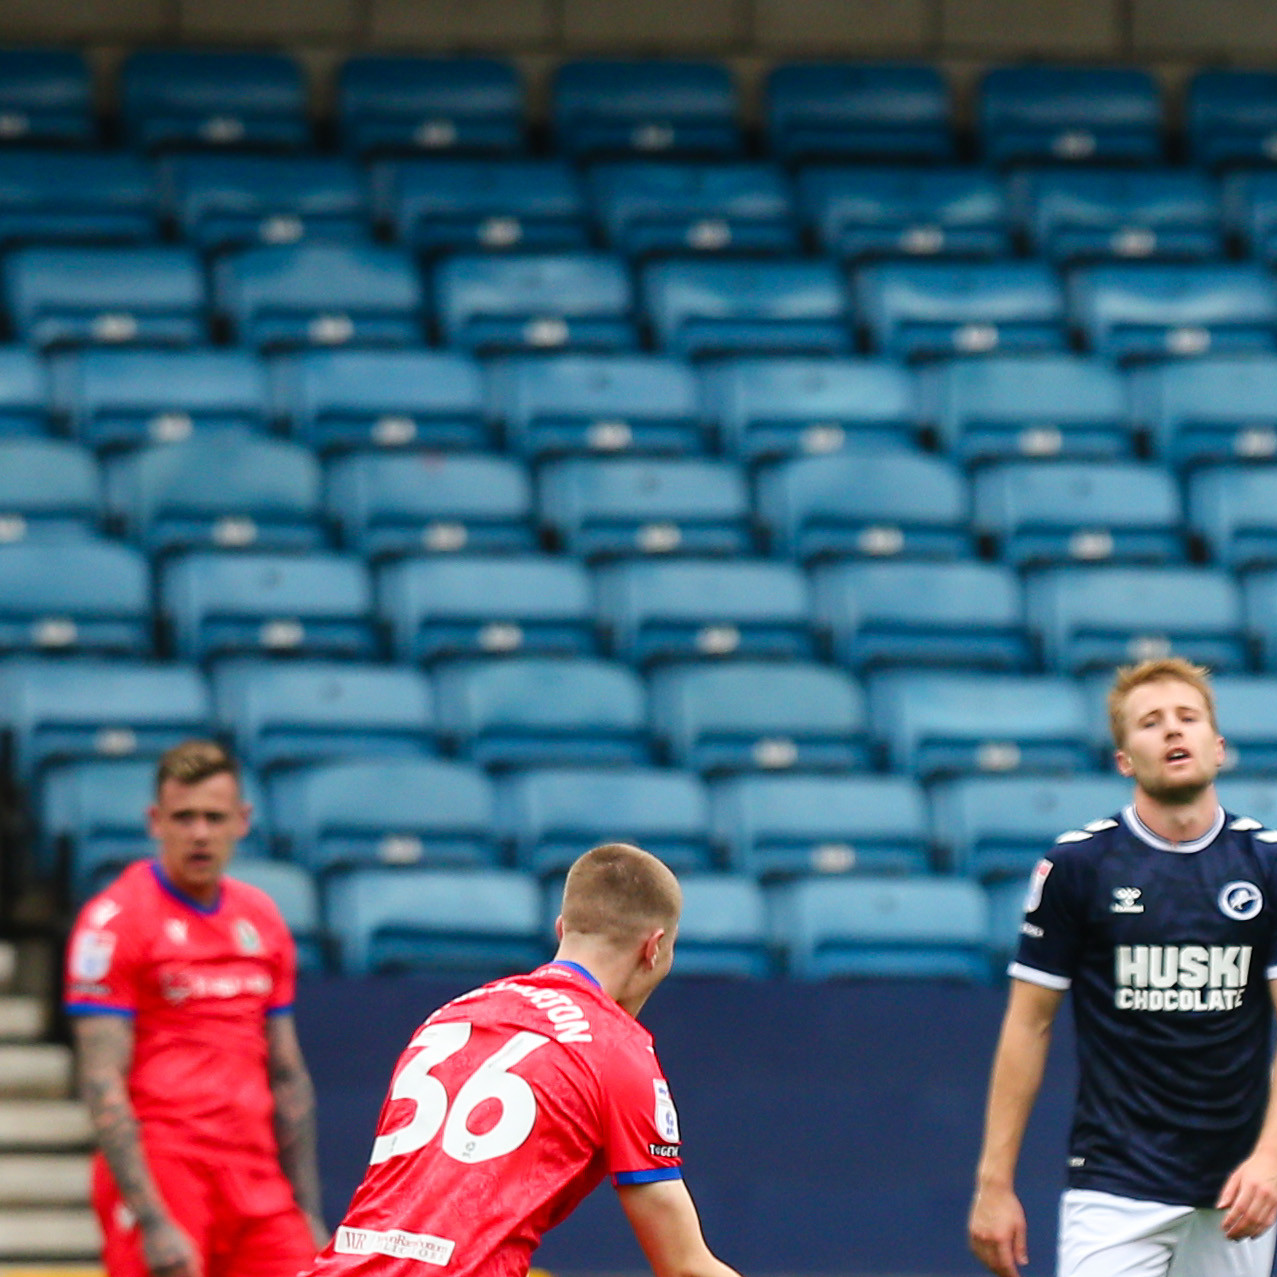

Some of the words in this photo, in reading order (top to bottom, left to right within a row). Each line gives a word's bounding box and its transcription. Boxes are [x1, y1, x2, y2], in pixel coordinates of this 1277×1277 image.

[1115, 945, 1252, 988] HUSKI
[1115, 987, 1246, 1011] CHOCOLATE
[370, 1022, 551, 1164] 36
